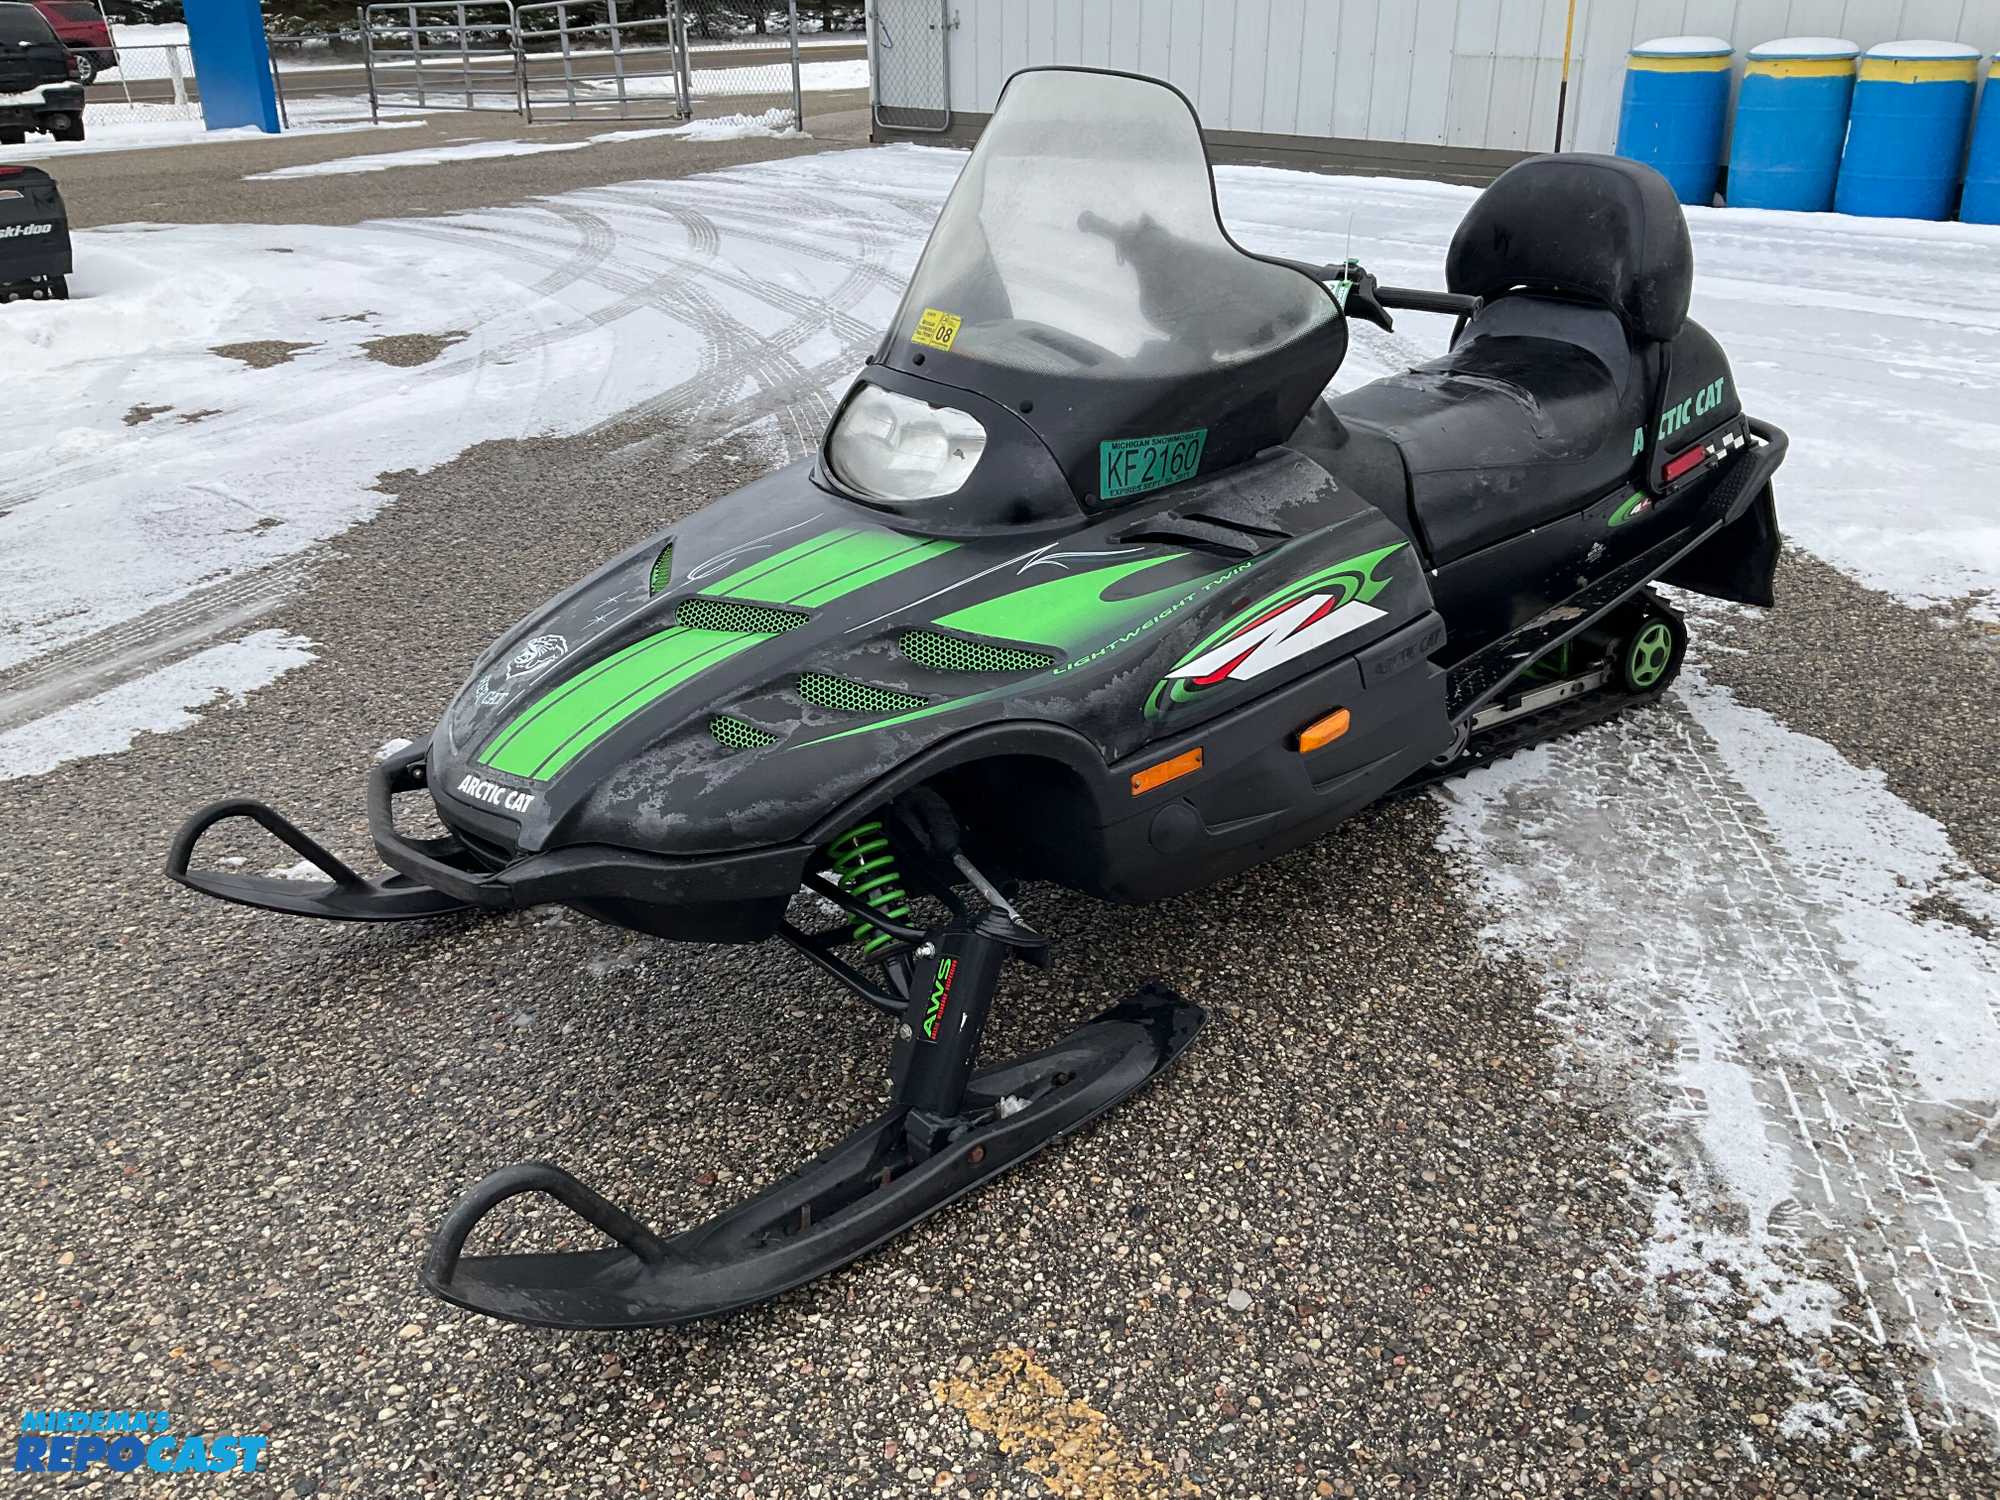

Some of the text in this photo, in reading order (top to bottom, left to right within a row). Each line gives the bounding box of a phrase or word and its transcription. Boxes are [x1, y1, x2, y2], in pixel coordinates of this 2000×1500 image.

[0, 223, 52, 239] ski-doo
[936, 326, 953, 343] 08
[1632, 377, 1724, 457] ACTIC CAT
[1107, 438, 1200, 489] KF2160
[1111, 432, 1200, 450] MICHIGAN SNOWMOBILE
[1052, 561, 1252, 676] LIGHTWEIGHT TWIN
[457, 774, 536, 813] ARCTIC CAT
[923, 958, 952, 1038] AWS
